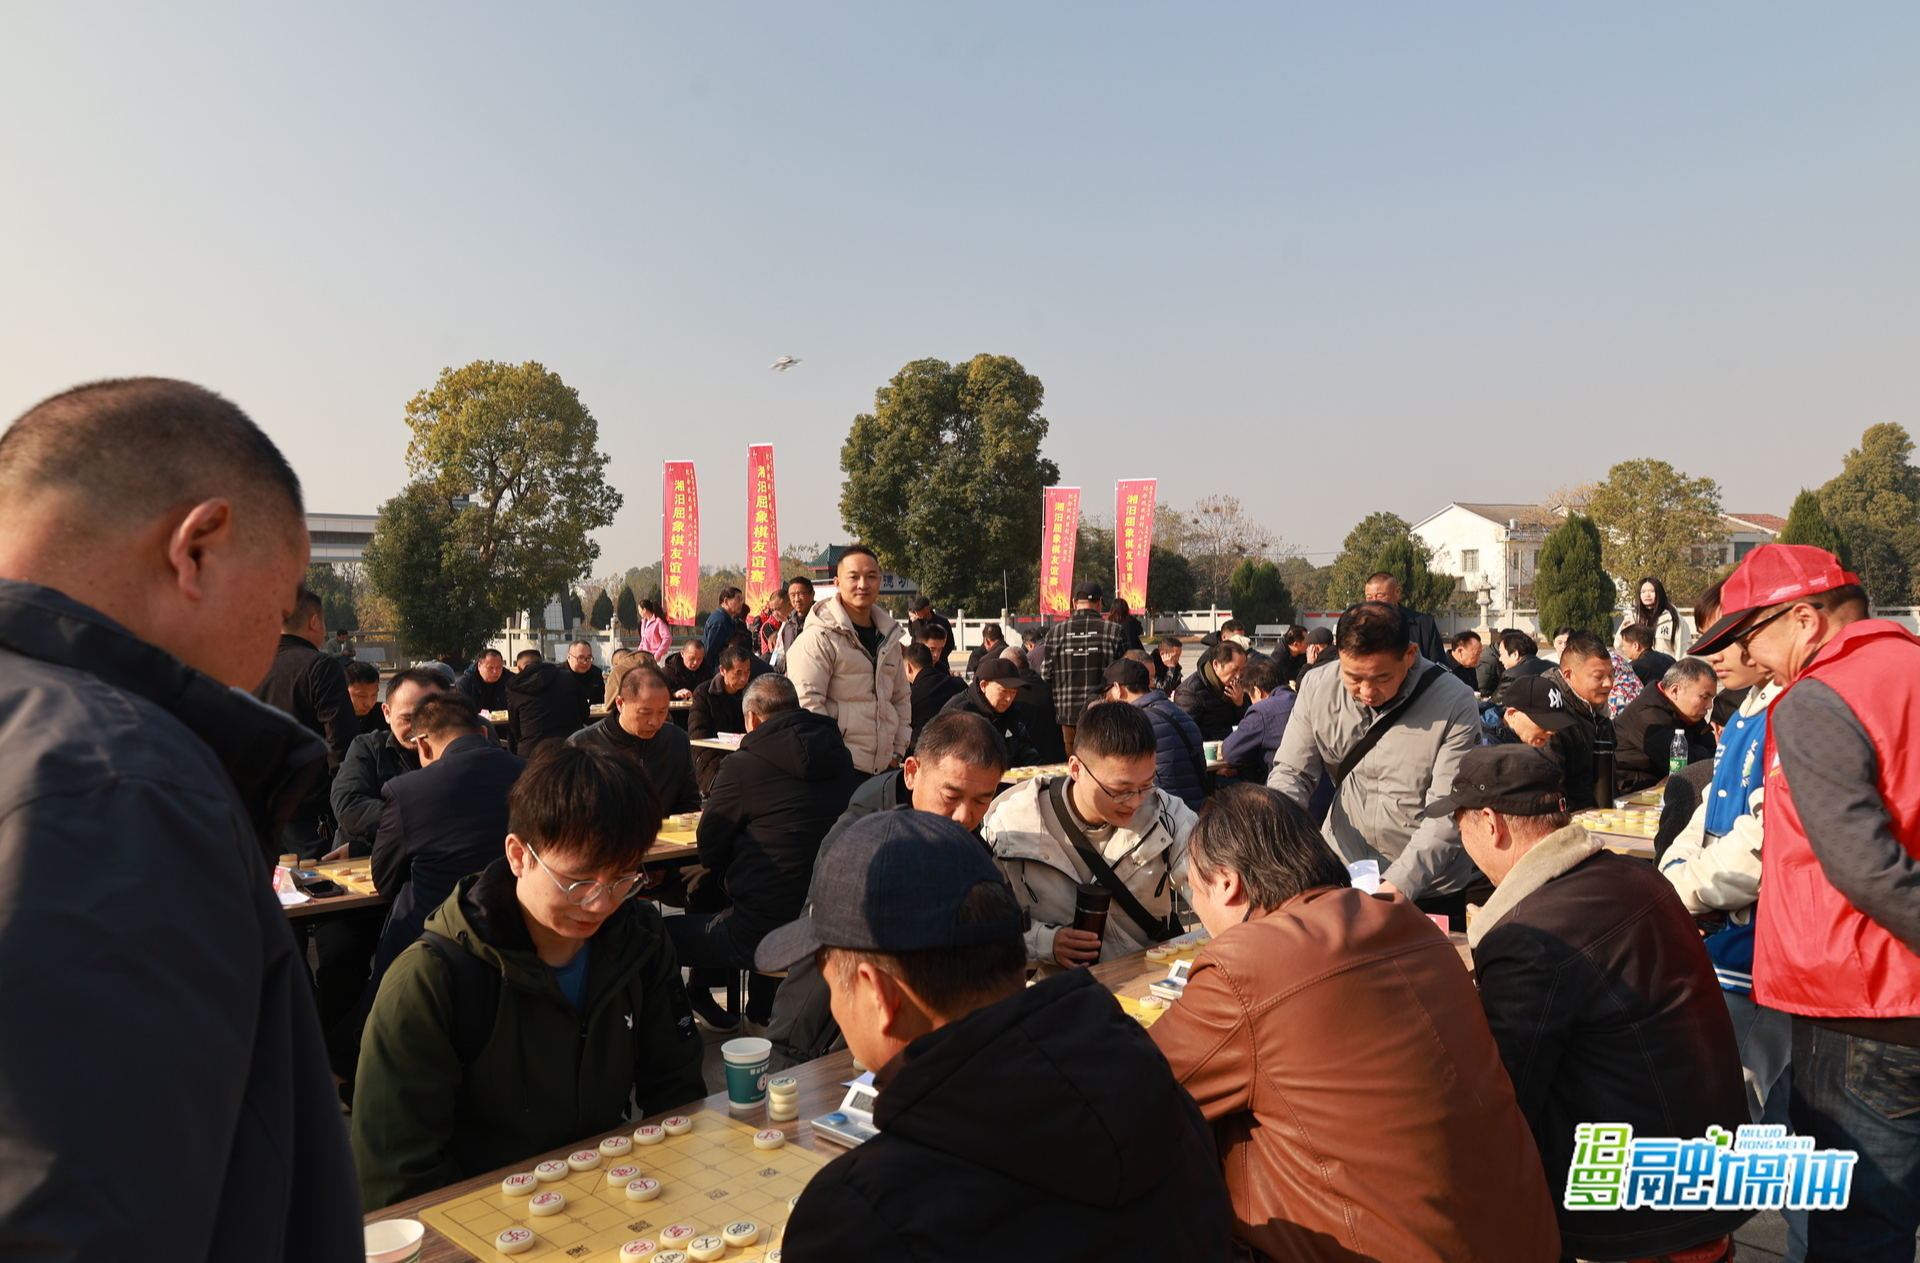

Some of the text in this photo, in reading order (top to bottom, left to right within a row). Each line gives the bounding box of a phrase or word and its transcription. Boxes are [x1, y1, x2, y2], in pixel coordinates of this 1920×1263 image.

[669, 480, 686, 588] 湘汨屈象棋友谊赛
[750, 465, 769, 584] 湘汨屈象棋友谊赛
[1049, 502, 1065, 587] 湘汨屈象棋友谊赛
[1124, 494, 1139, 584] 湘汨屈象棋友谊赛
